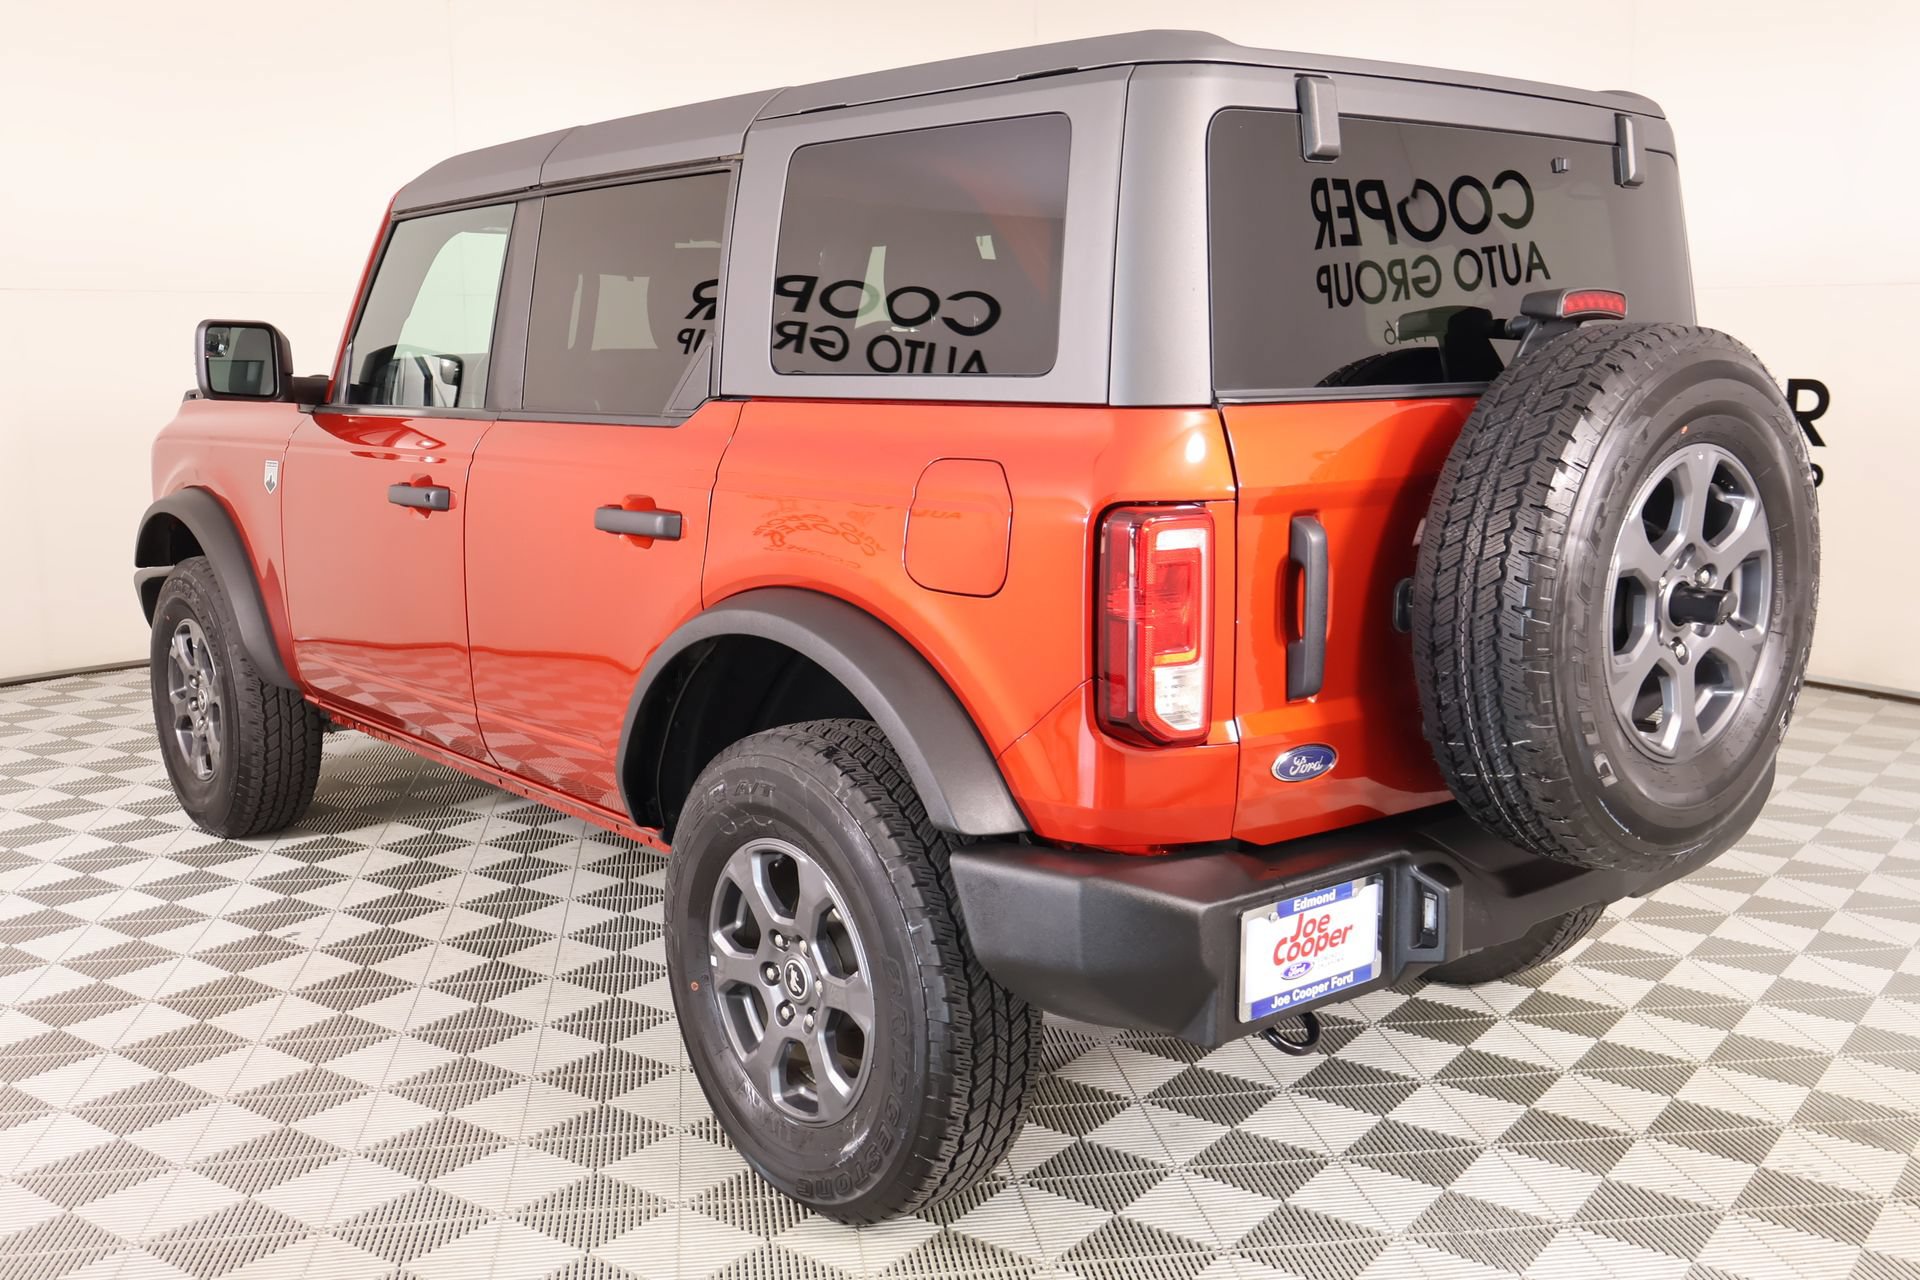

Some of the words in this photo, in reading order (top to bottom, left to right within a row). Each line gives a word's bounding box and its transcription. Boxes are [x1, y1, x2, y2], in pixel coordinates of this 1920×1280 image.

[1293, 889, 1336, 911] Edmond
[1290, 912, 1331, 943] Joe
[1273, 925, 1353, 965] Cooper
[1271, 992, 1290, 1009] Joe
[1292, 981, 1329, 998] Cooper
[1331, 971, 1354, 988] Ford
